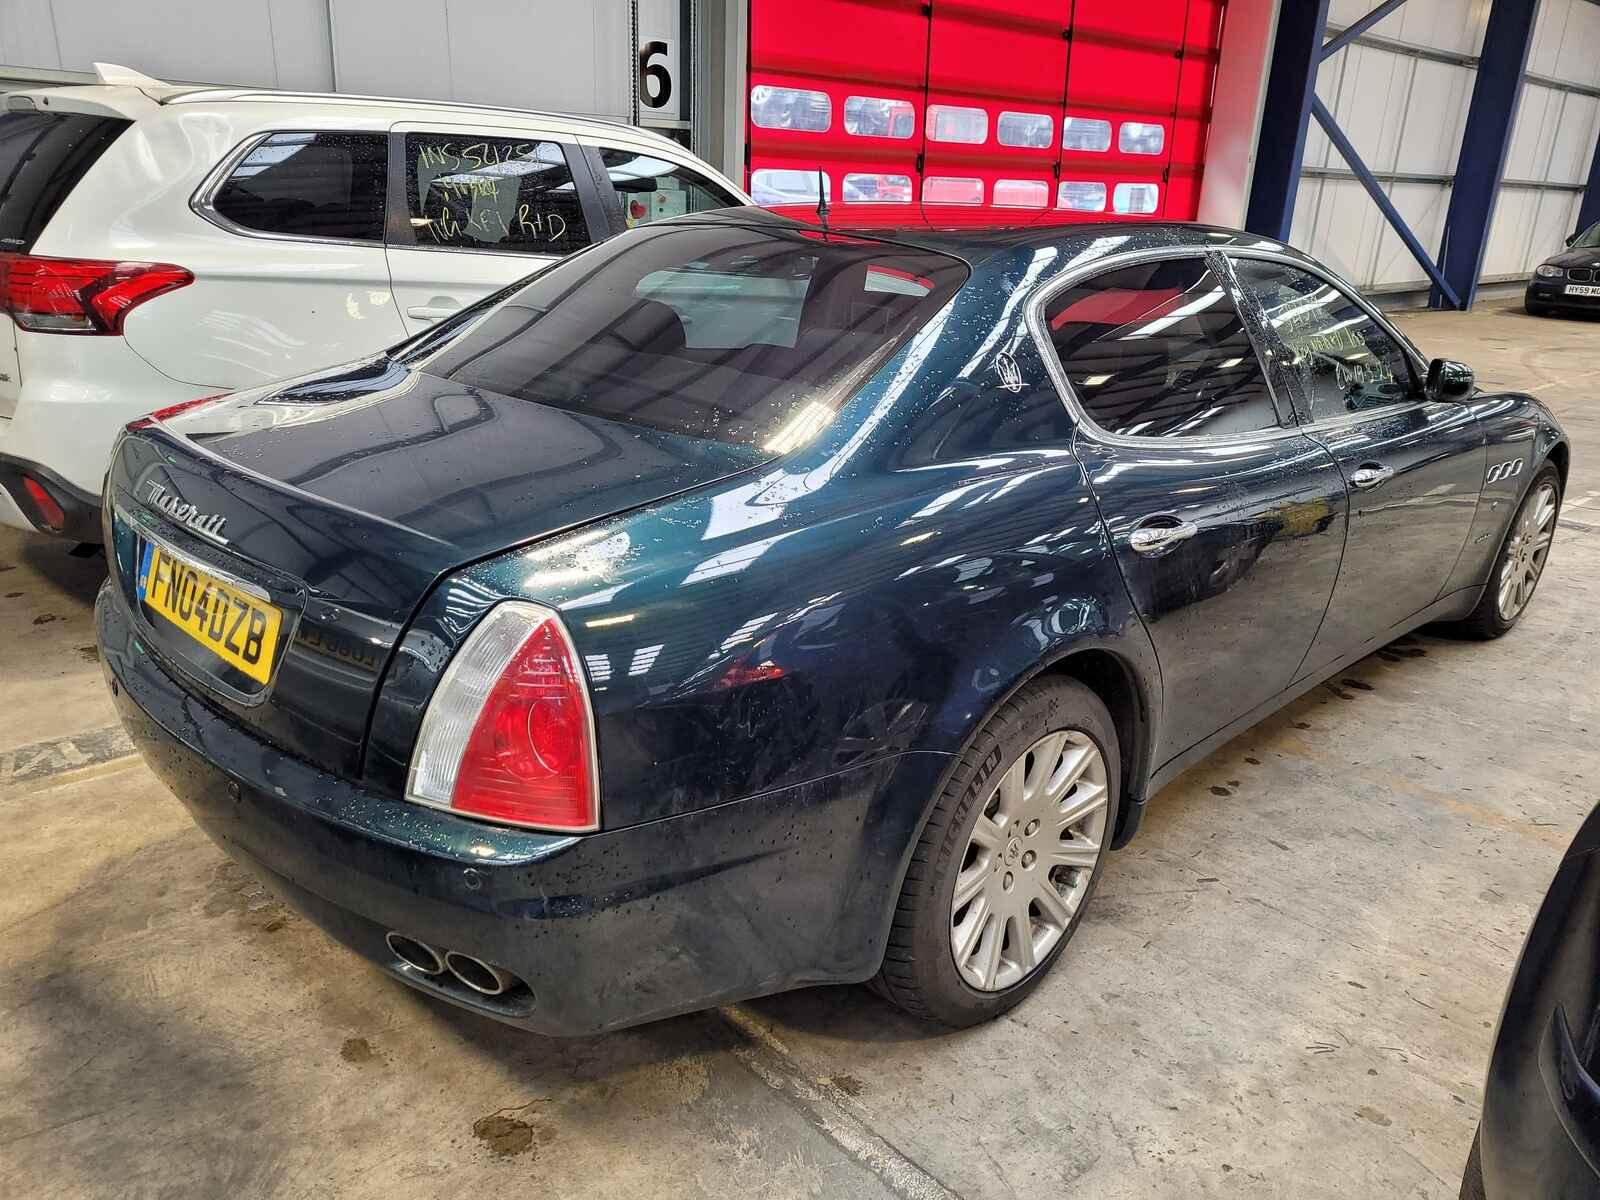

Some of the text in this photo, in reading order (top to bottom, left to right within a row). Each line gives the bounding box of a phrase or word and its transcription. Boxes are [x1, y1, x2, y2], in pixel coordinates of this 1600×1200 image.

[639, 40, 672, 108] 6
[146, 480, 230, 545] Maserati
[152, 550, 268, 665] FN04DZB
